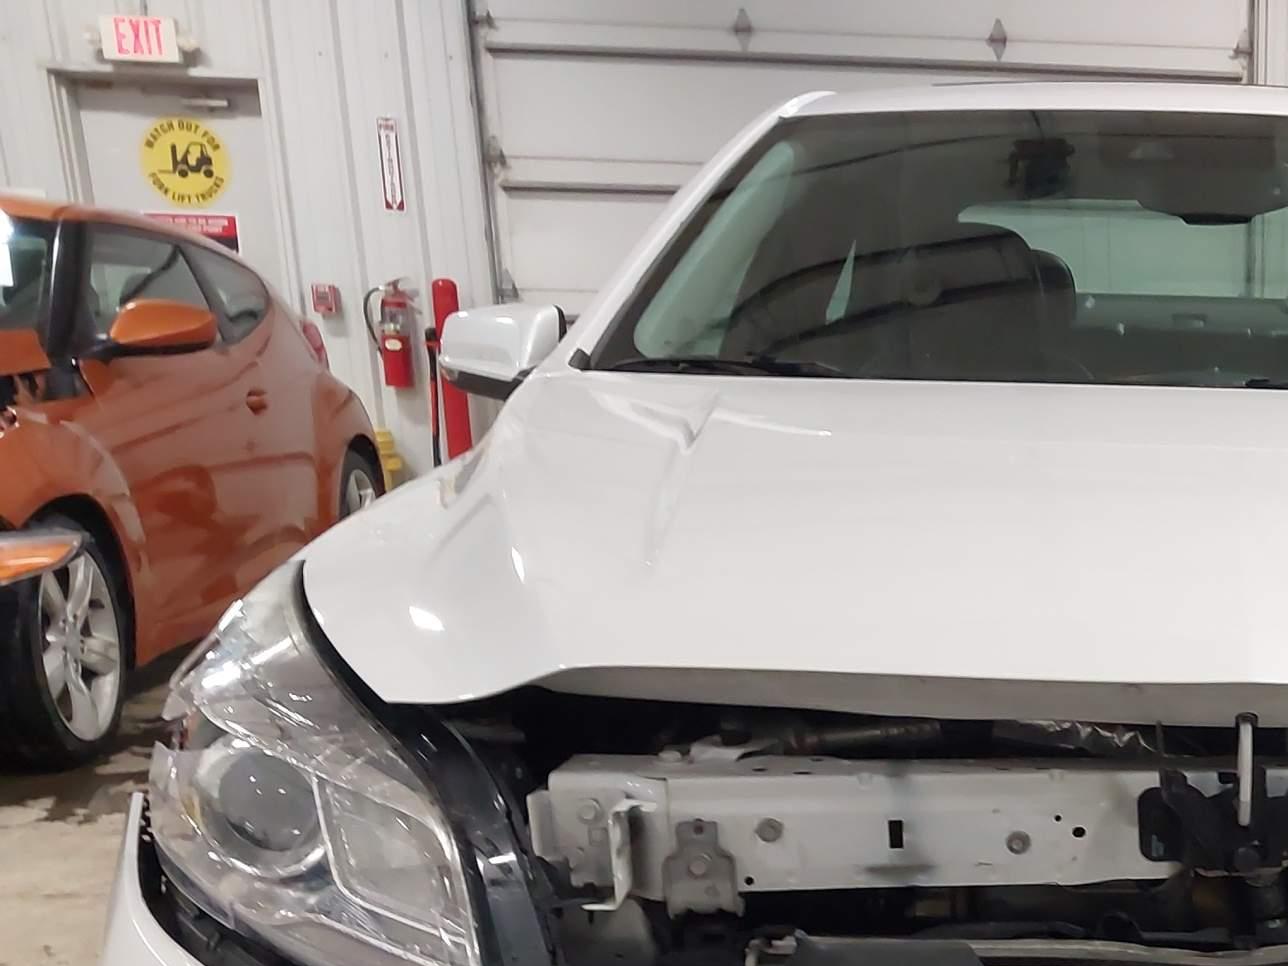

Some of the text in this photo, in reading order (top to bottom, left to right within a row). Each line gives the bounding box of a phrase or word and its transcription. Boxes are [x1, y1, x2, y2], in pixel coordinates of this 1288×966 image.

[113, 17, 163, 55] EXIT
[145, 120, 175, 149] WATCH
[177, 119, 200, 134] OUT
[171, 191, 192, 204] LIFT
